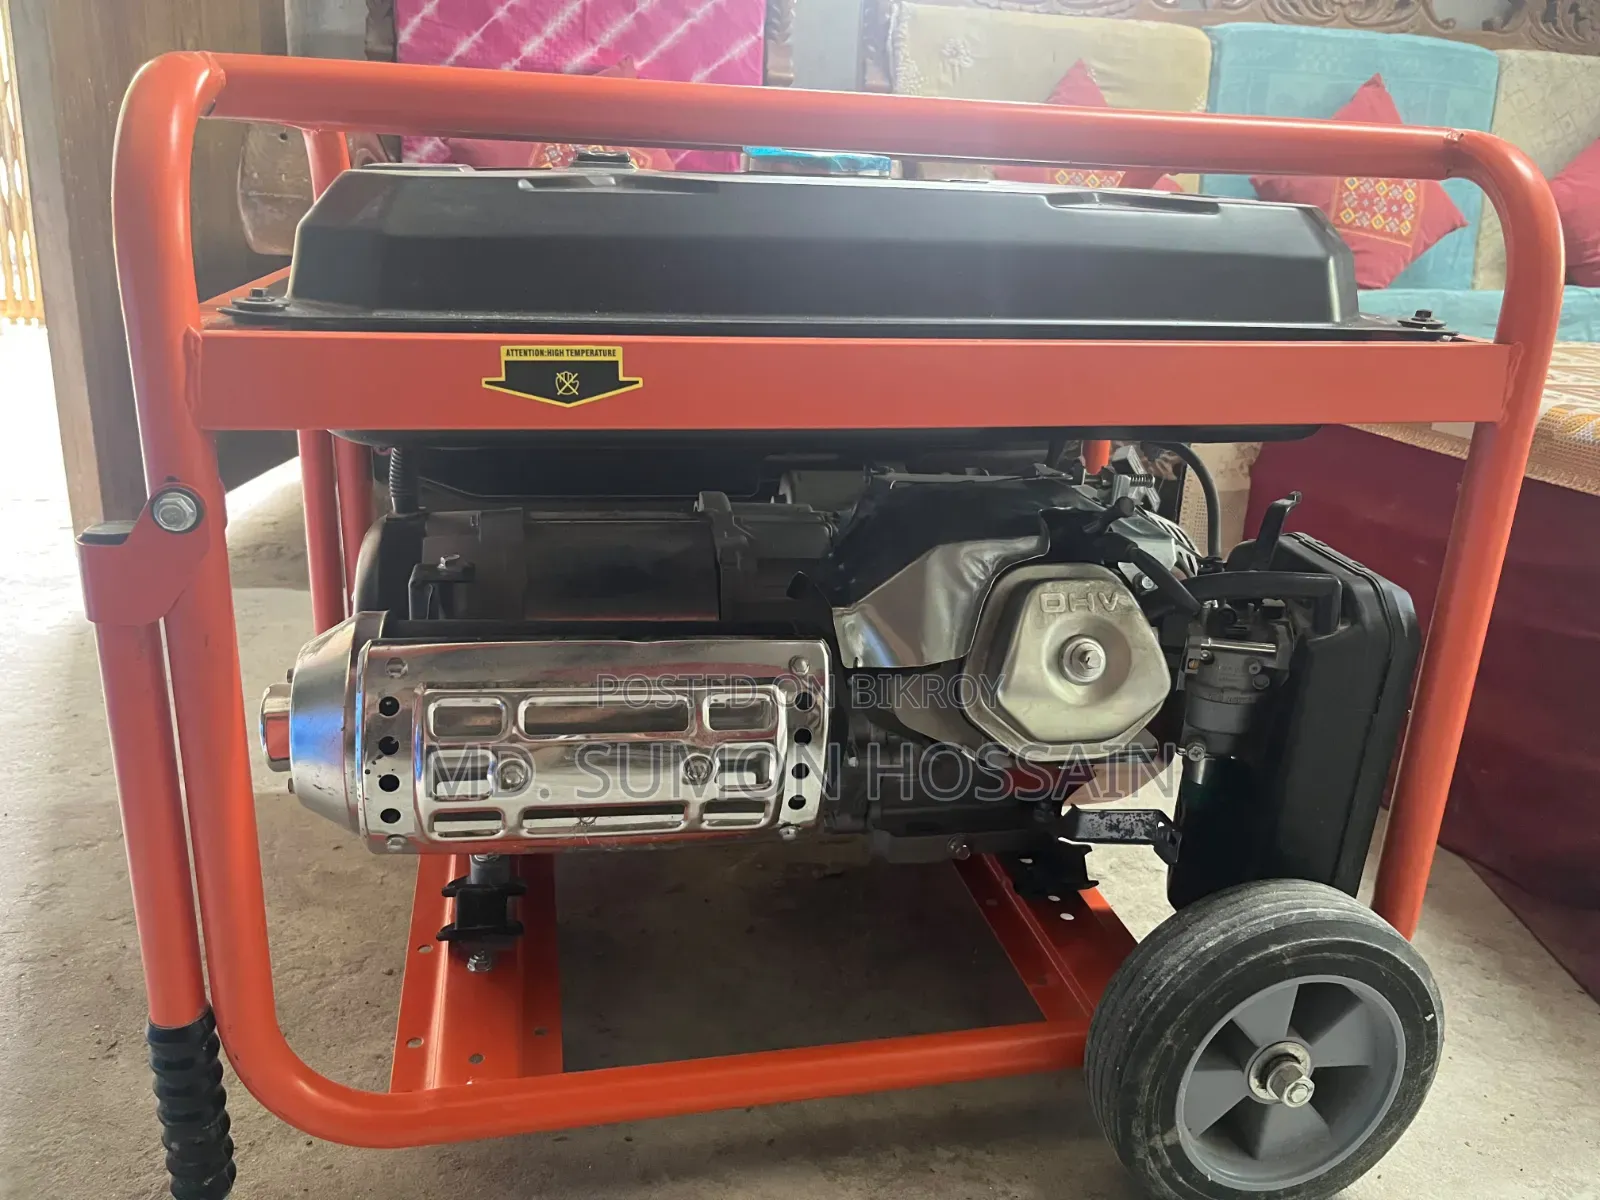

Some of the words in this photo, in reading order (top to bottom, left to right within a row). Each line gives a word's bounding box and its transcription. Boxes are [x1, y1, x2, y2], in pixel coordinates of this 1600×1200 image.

[505, 348, 565, 357] ATTENTION:HIGH
[566, 348, 617, 357] TEMPERATURE
[1039, 591, 1120, 613] OHV
